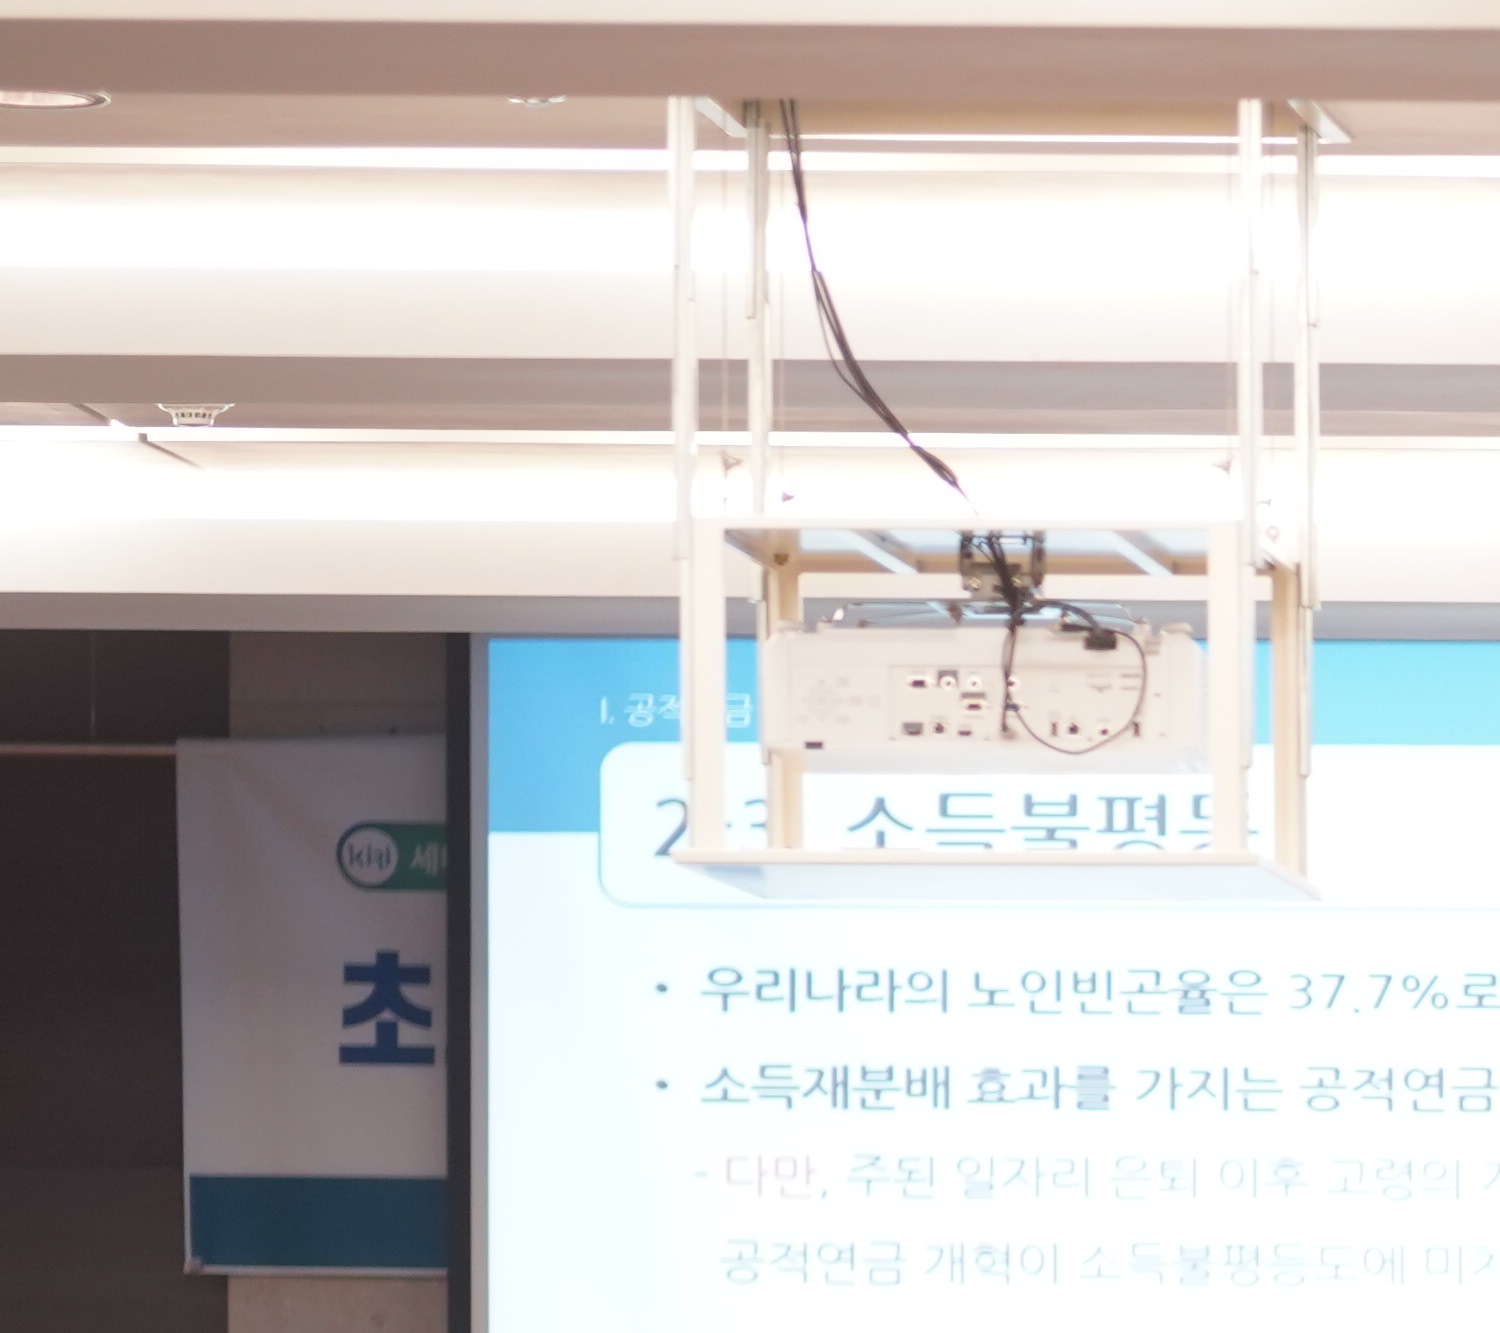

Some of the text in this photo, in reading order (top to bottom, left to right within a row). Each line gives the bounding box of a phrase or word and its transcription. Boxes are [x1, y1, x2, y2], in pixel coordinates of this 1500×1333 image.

[624, 692, 753, 728] 공적금
[408, 840, 447, 876] 세
[338, 949, 436, 1067] 초
[700, 965, 949, 1015] 우리나라의
[967, 968, 1268, 1016] 노인빈곤율은
[700, 1063, 952, 1112] 소득재분배
[967, 1064, 1117, 1112] 효과를
[1136, 1065, 1284, 1114] 가지는
[1299, 1065, 1499, 1114] 공적연금
[724, 1154, 830, 1202] 다만,
[846, 1152, 936, 1201] 주된
[954, 1154, 1091, 1201] 일자리
[1109, 1154, 1199, 1202] 은퇴
[1218, 1155, 1308, 1200] 이후
[1326, 1157, 1462, 1202] 고령의
[719, 1238, 908, 1287] 공적연금
[924, 1241, 1059, 1285] 개혁이
[1077, 1241, 1406, 1289] 소득불평등도에
